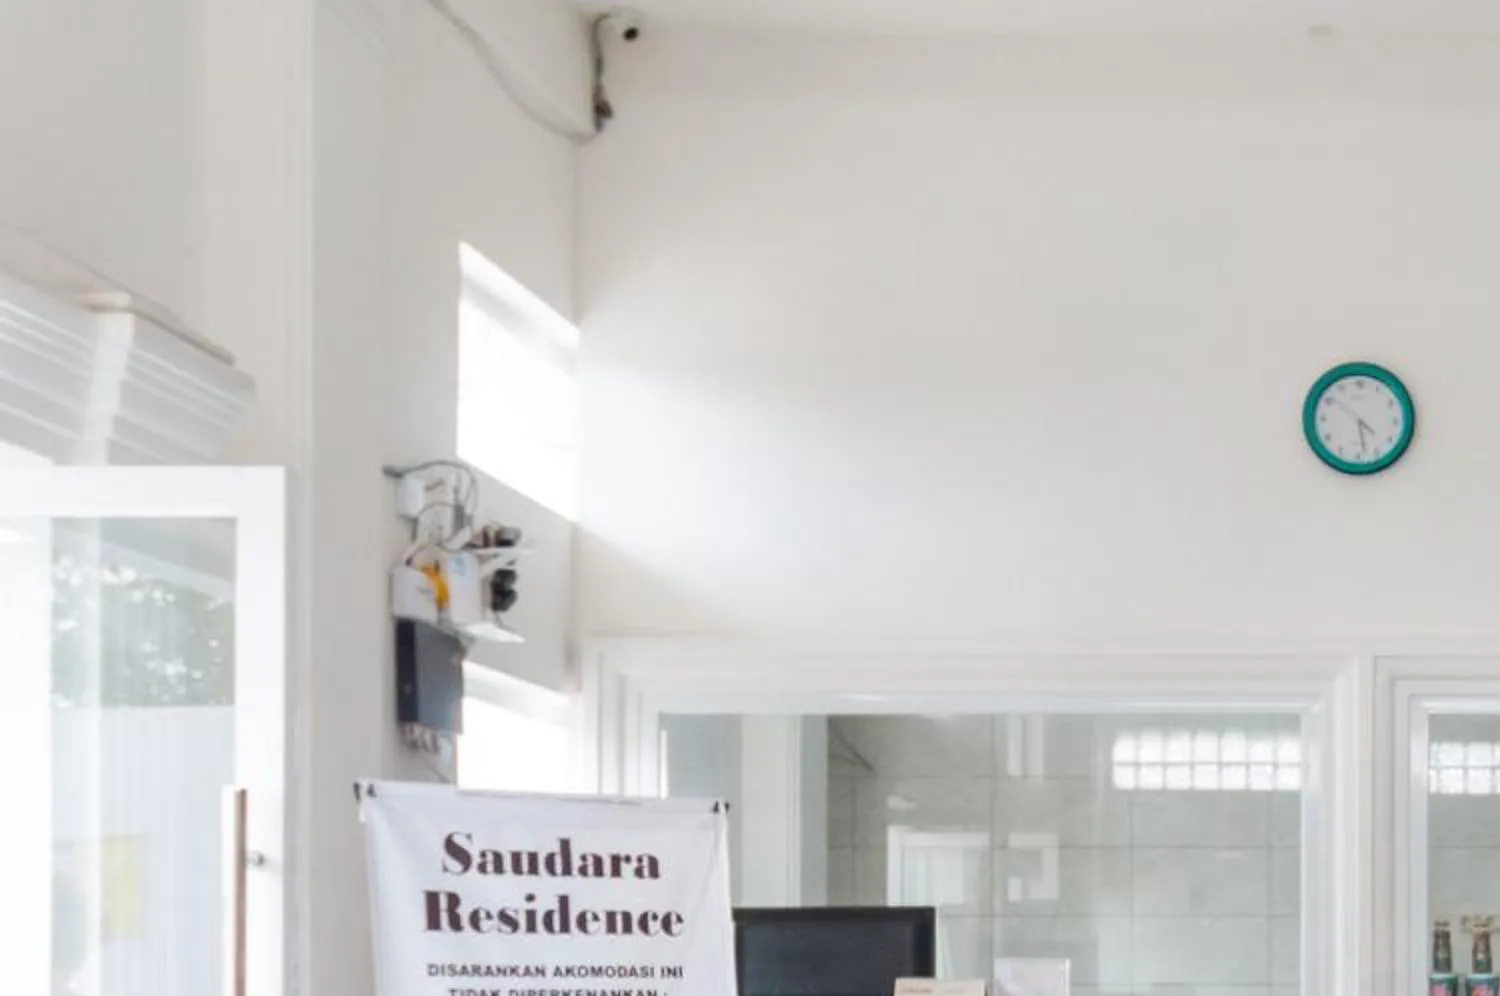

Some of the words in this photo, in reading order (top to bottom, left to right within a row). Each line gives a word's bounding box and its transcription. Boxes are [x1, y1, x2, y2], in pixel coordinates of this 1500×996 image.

[443, 832, 661, 880] Saudara
[424, 890, 684, 937] Residence
[428, 963, 546, 978] DISARANKAN
[553, 965, 655, 978] AKOMODASI
[661, 966, 683, 979] INI
